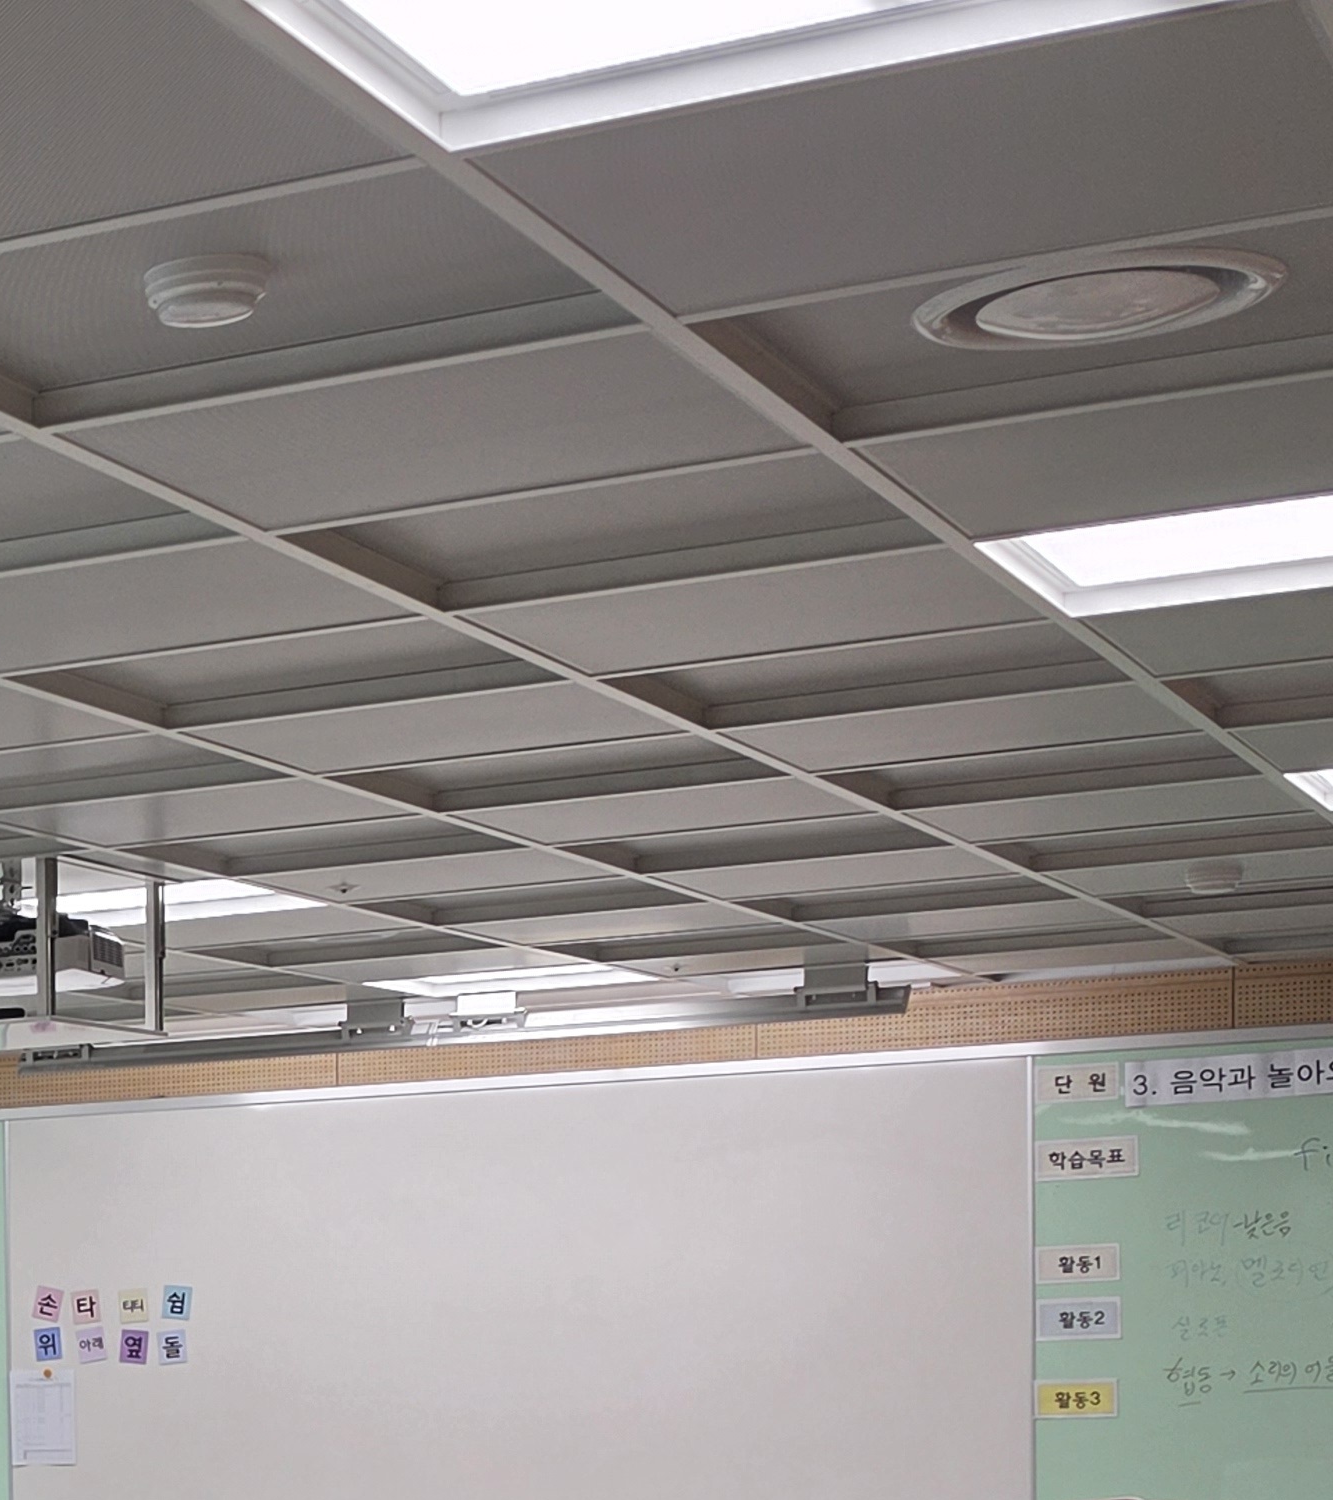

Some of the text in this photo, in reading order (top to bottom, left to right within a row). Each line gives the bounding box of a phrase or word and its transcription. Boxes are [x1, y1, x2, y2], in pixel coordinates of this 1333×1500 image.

[1132, 1074, 1158, 1096] 3.
[1170, 1065, 1257, 1095] 음악과
[1048, 1148, 1126, 1171] 학습목표
[1058, 1255, 1102, 1274] 활동1
[37, 1293, 59, 1317] 손
[75, 1295, 97, 1318] 타
[1058, 1310, 1106, 1330] 활동2
[38, 1333, 57, 1356] 위
[78, 1336, 105, 1353] 아래
[123, 1335, 144, 1360] 옆
[1054, 1390, 1102, 1410] 활동3
